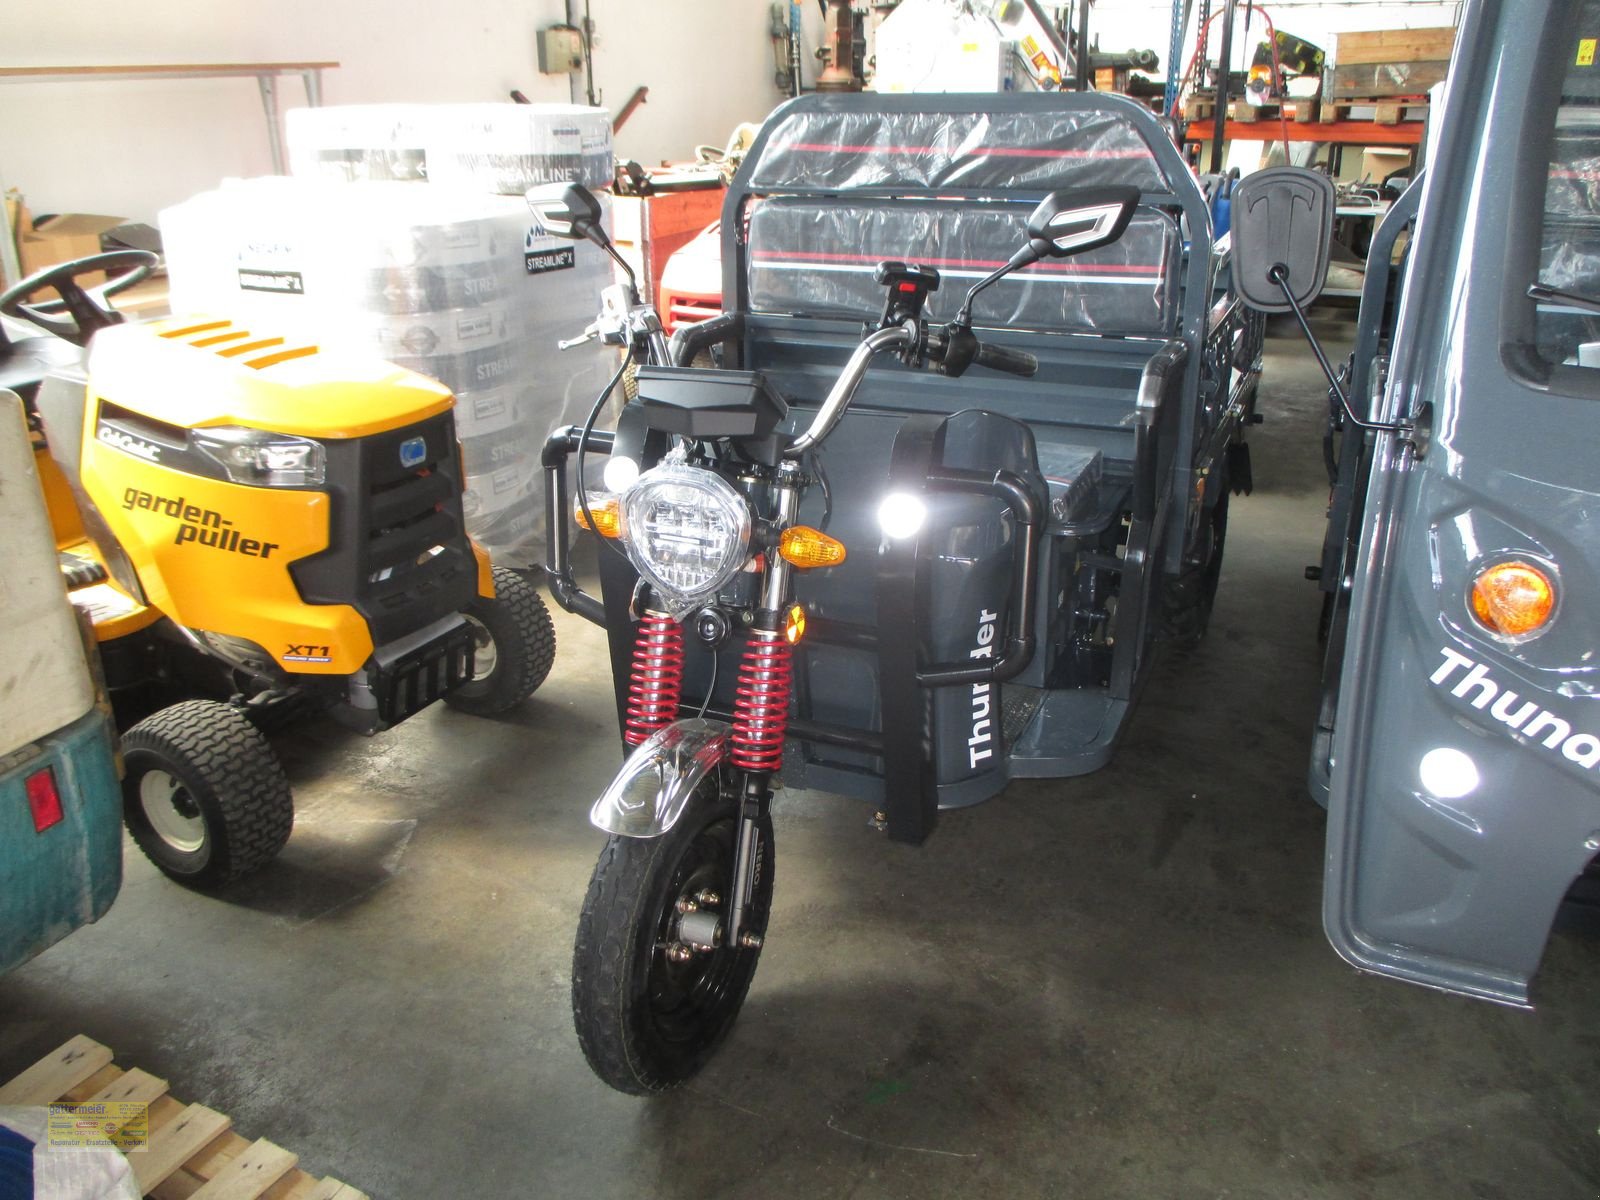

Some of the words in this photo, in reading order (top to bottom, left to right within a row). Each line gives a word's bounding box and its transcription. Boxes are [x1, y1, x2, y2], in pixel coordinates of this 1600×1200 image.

[122, 487, 233, 529] garden-
[174, 523, 280, 559] puller
[284, 643, 330, 657] XT1
